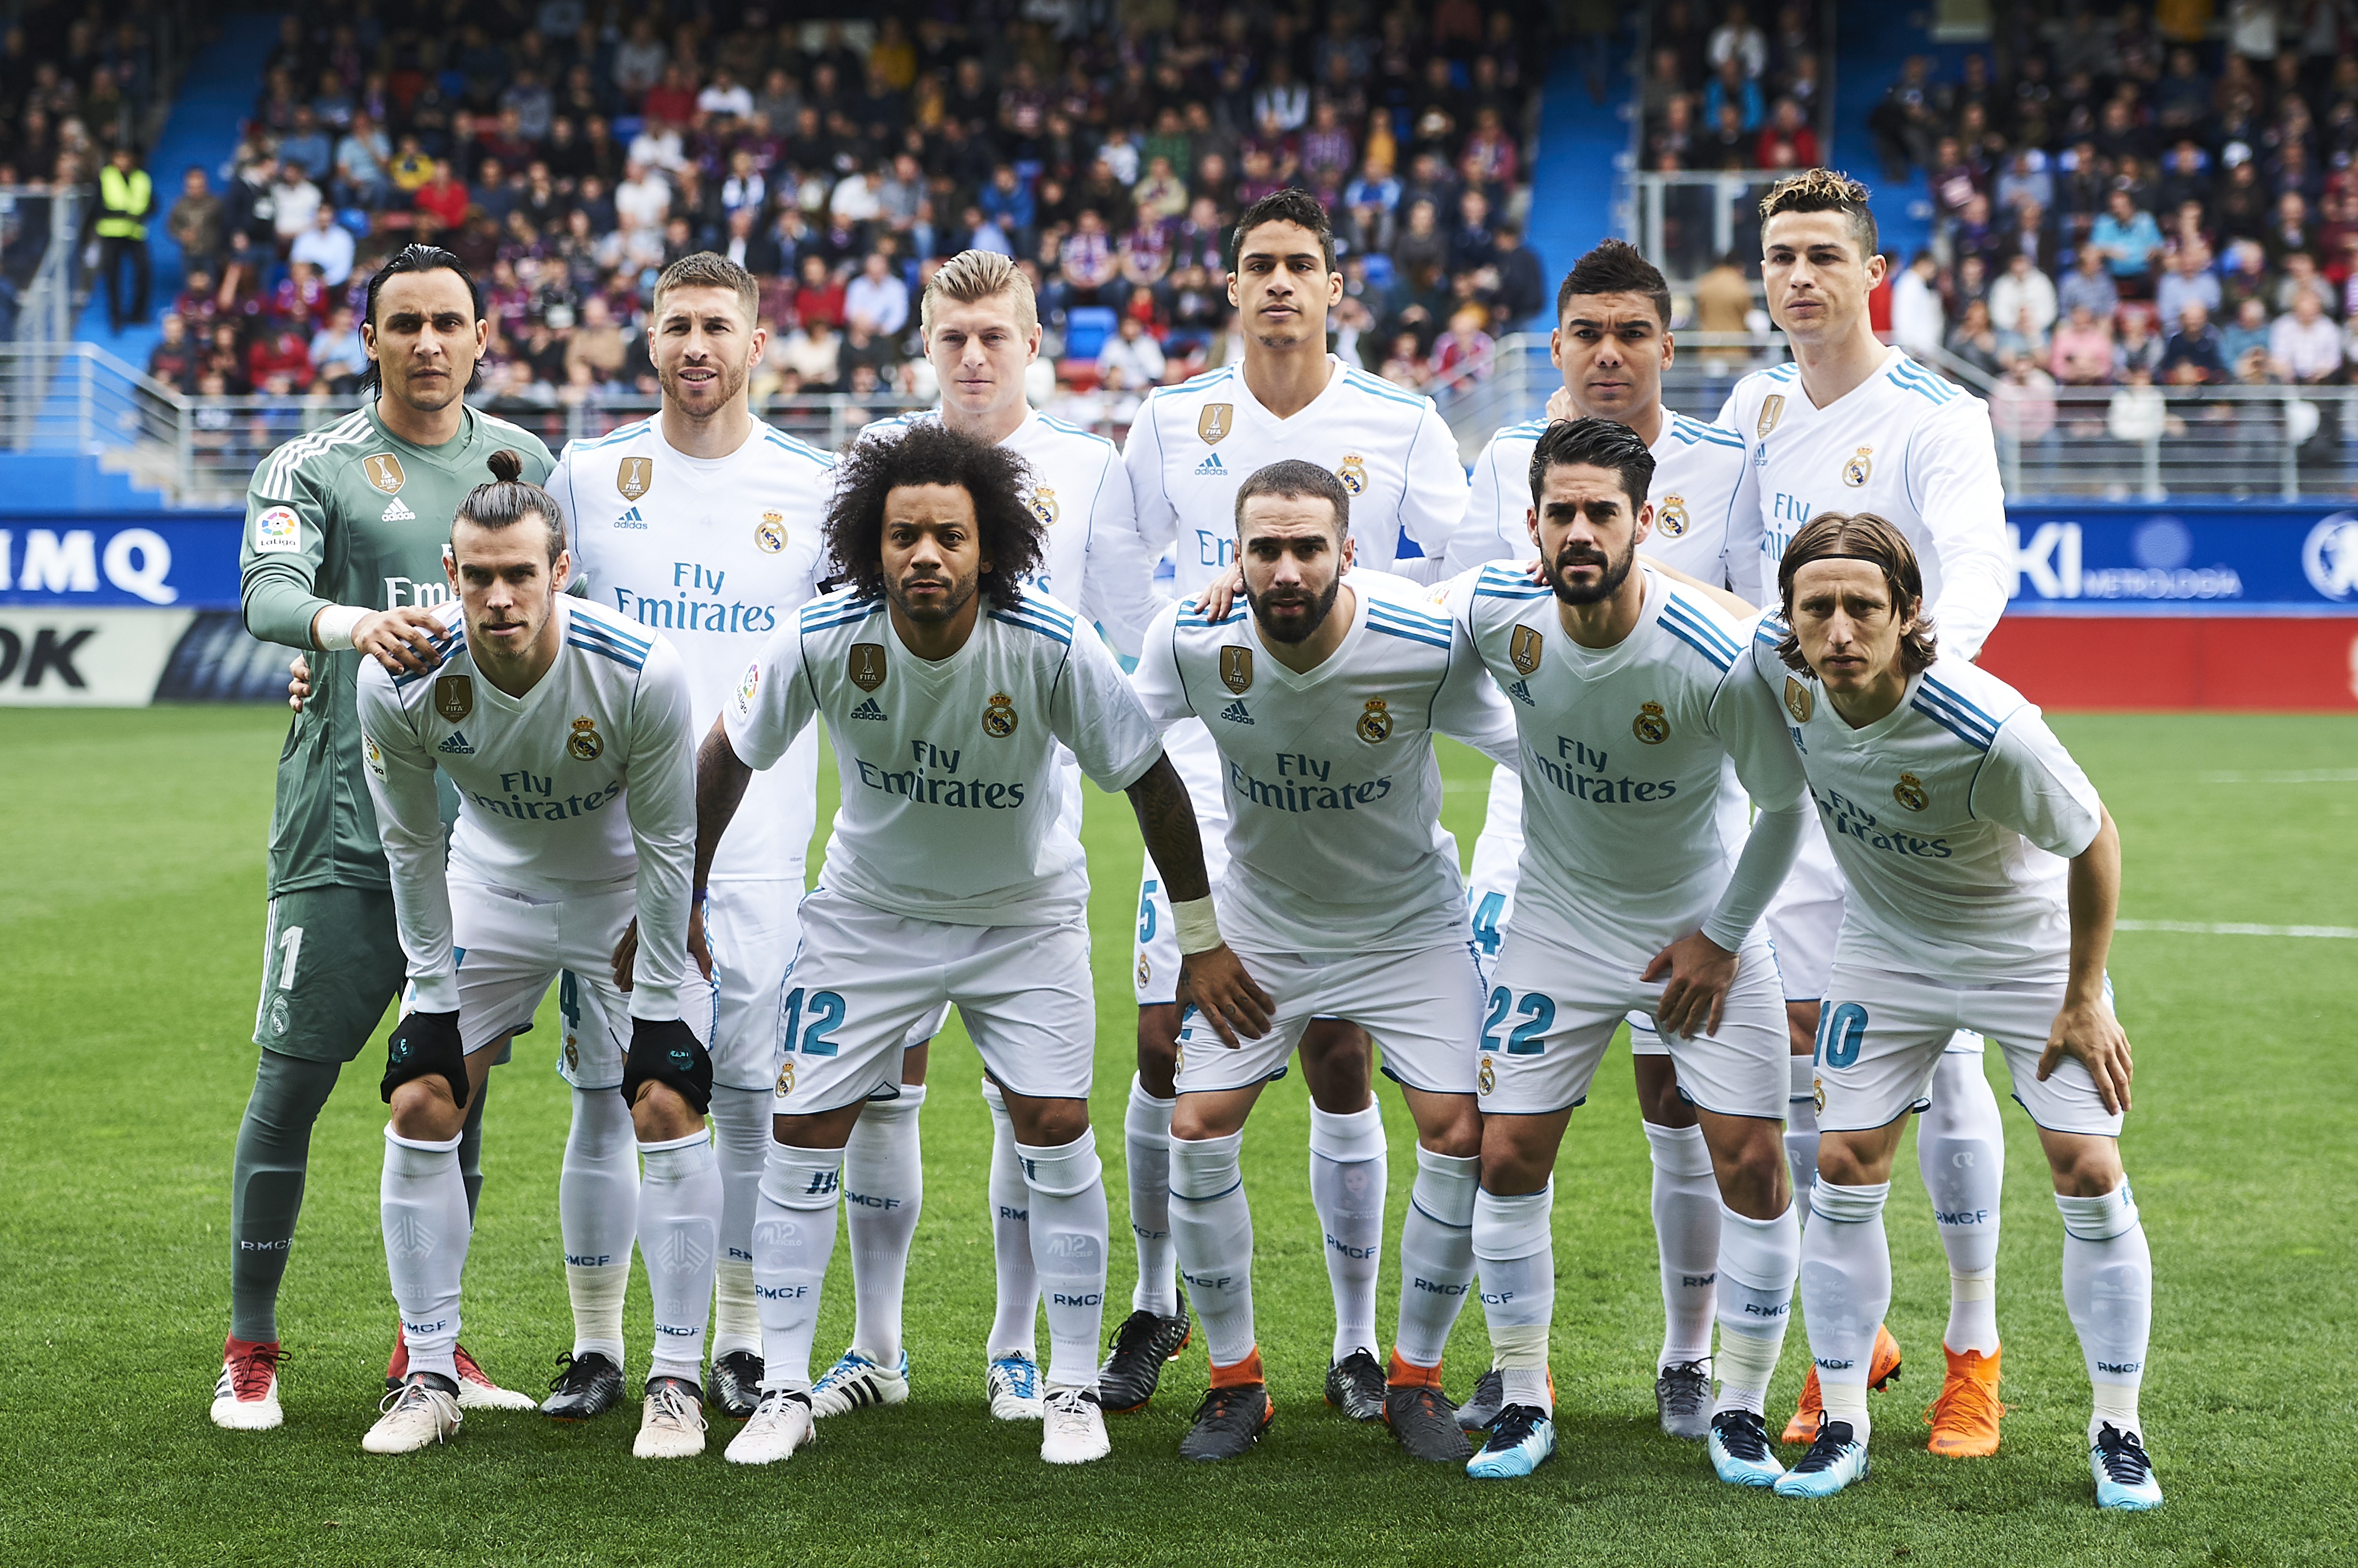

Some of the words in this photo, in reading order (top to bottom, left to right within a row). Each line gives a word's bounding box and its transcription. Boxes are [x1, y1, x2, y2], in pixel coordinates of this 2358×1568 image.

[1195, 467, 1228, 475] adidas
[382, 511, 415, 522] adidas
[1775, 493, 1810, 528] Fly
[614, 521, 648, 529] adidas
[261, 538, 296, 546] LaLiga
[673, 562, 725, 595] Fly
[614, 586, 775, 632] Emirates
[1518, 655, 1531, 665] FIFA
[1509, 686, 1535, 706] adidas
[851, 711, 888, 721] adidas
[1221, 712, 1254, 725] adidas
[438, 745, 475, 754] adidas
[912, 740, 960, 773] Fly
[1557, 735, 1607, 772] Fly
[1276, 753, 1330, 782] Fly
[500, 770, 552, 796] Fly
[855, 757, 1024, 809] Emirates
[1229, 759, 1392, 813] Emirates
[470, 780, 620, 821] mirates
[1828, 788, 1876, 826] Fly
[1140, 879, 1157, 943] 5
[279, 925, 303, 990] 1
[560, 968, 581, 1030] 4
[784, 987, 846, 1056] 12
[1478, 986, 1556, 1054] 22
[1813, 1001, 1868, 1068] 10
[845, 1189, 900, 1210] RMCF
[1000, 1206, 1029, 1221] RM
[1935, 1210, 1987, 1225] RMCF
[730, 1247, 752, 1261] RM
[1327, 1234, 1377, 1259] RMCF
[1180, 1269, 1230, 1288] MCF
[1415, 1277, 1470, 1295] RMCF
[1683, 1273, 1715, 1287] RM
[756, 1285, 808, 1300] RMCF
[656, 1324, 699, 1336] RMCF
[2098, 1361, 2142, 1373] RMCF
